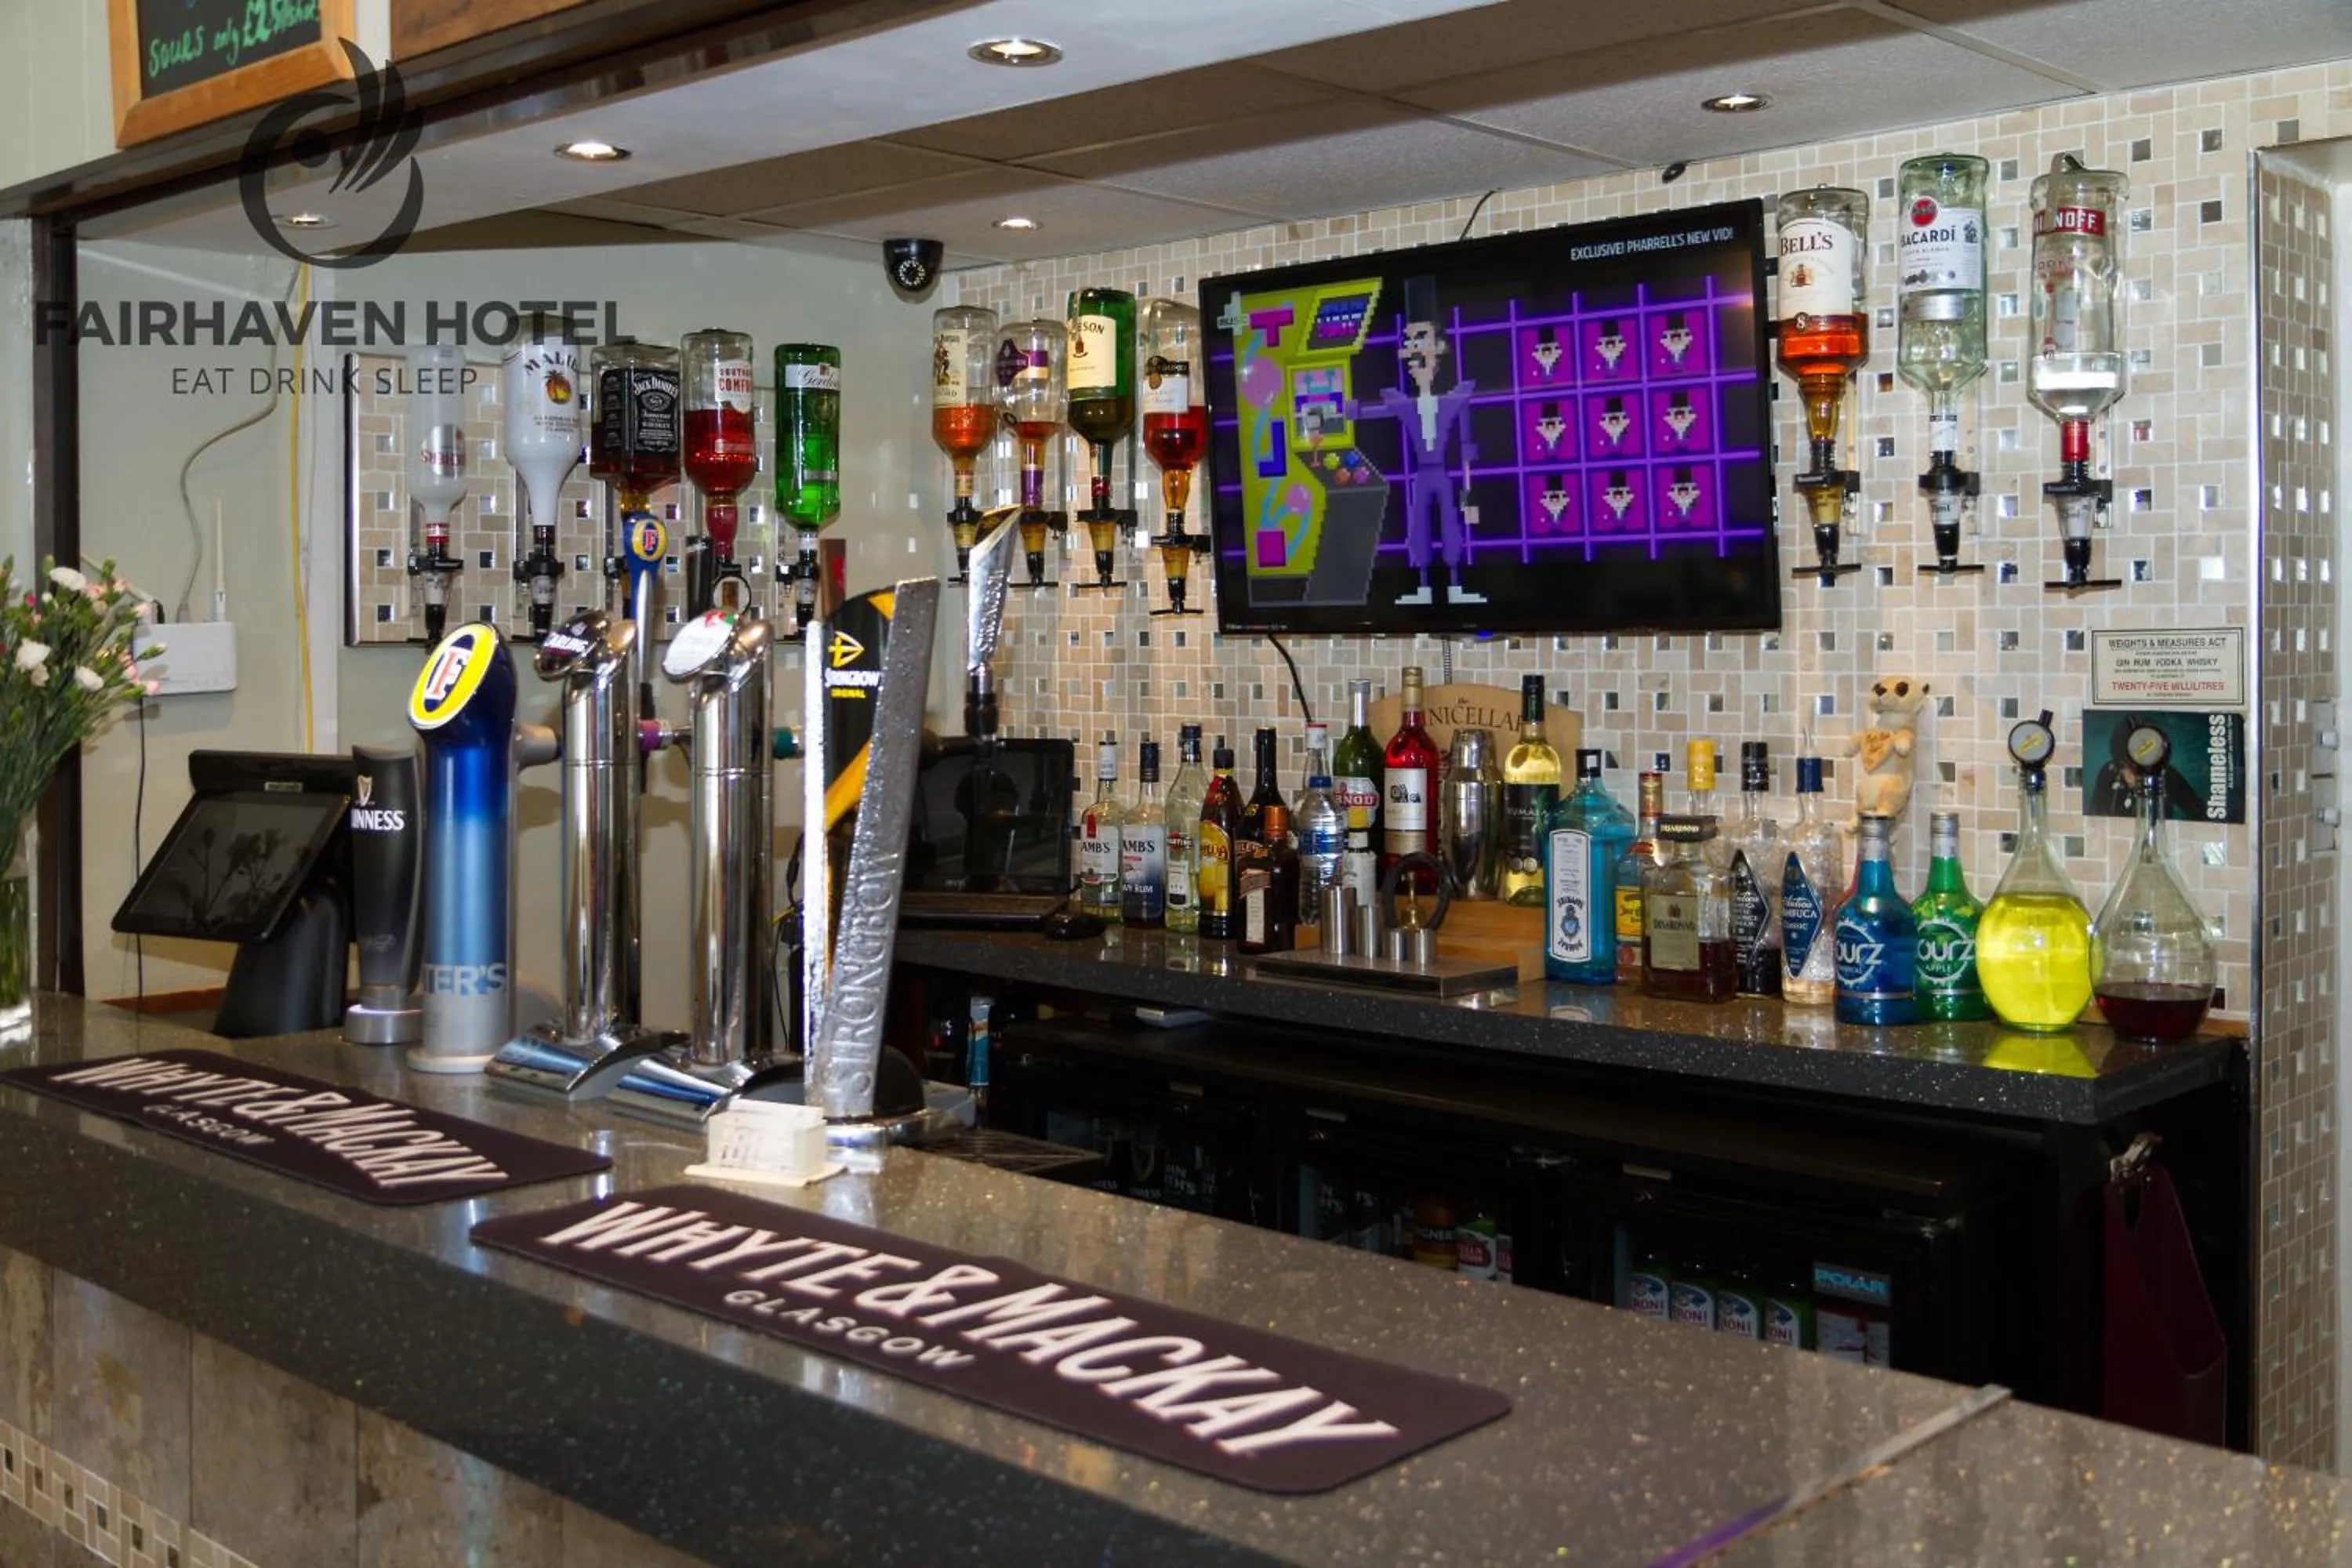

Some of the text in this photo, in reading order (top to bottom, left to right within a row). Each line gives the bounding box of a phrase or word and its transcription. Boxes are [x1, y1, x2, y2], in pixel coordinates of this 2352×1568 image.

[1570, 241, 1624, 260] EXCLUSIVE!
[1627, 234, 1685, 252] PHARRELL'S
[1687, 229, 1711, 245] NEW
[1780, 231, 1833, 256] BELL'S
[524, 351, 578, 377] MALIB
[633, 380, 652, 396] JACK
[718, 378, 753, 393] COMFO
[644, 529, 659, 550] F
[2108, 637, 2227, 648] WEIGHTS & MEASURES ACT
[424, 646, 472, 700] F
[2155, 658, 2182, 666] VODKA
[2112, 681, 2225, 691] TWENTY-FIVE MILLILITRES
[2207, 714, 2227, 819] Shameless
[1334, 794, 1374, 806] RNOD
[351, 808, 405, 831] INNESS
[1080, 840, 1111, 853] AMB'S
[1123, 840, 1155, 853] AMB'S
[1837, 942, 1885, 965] ourz
[1918, 939, 1976, 962] ourz
[426, 963, 507, 998] TER'S
[1926, 964, 1952, 974] APPLE
[49, 1058, 309, 1106] WHYTE
[282, 1102, 510, 1188] MACKAY
[143, 1104, 274, 1145] GLASGOW
[1631, 1295, 1664, 1312] RONI
[1675, 1308, 1708, 1324] RONI
[541, 1201, 1400, 1458] WHYTE & MACKAY
[723, 1288, 976, 1370] GLASGOW
